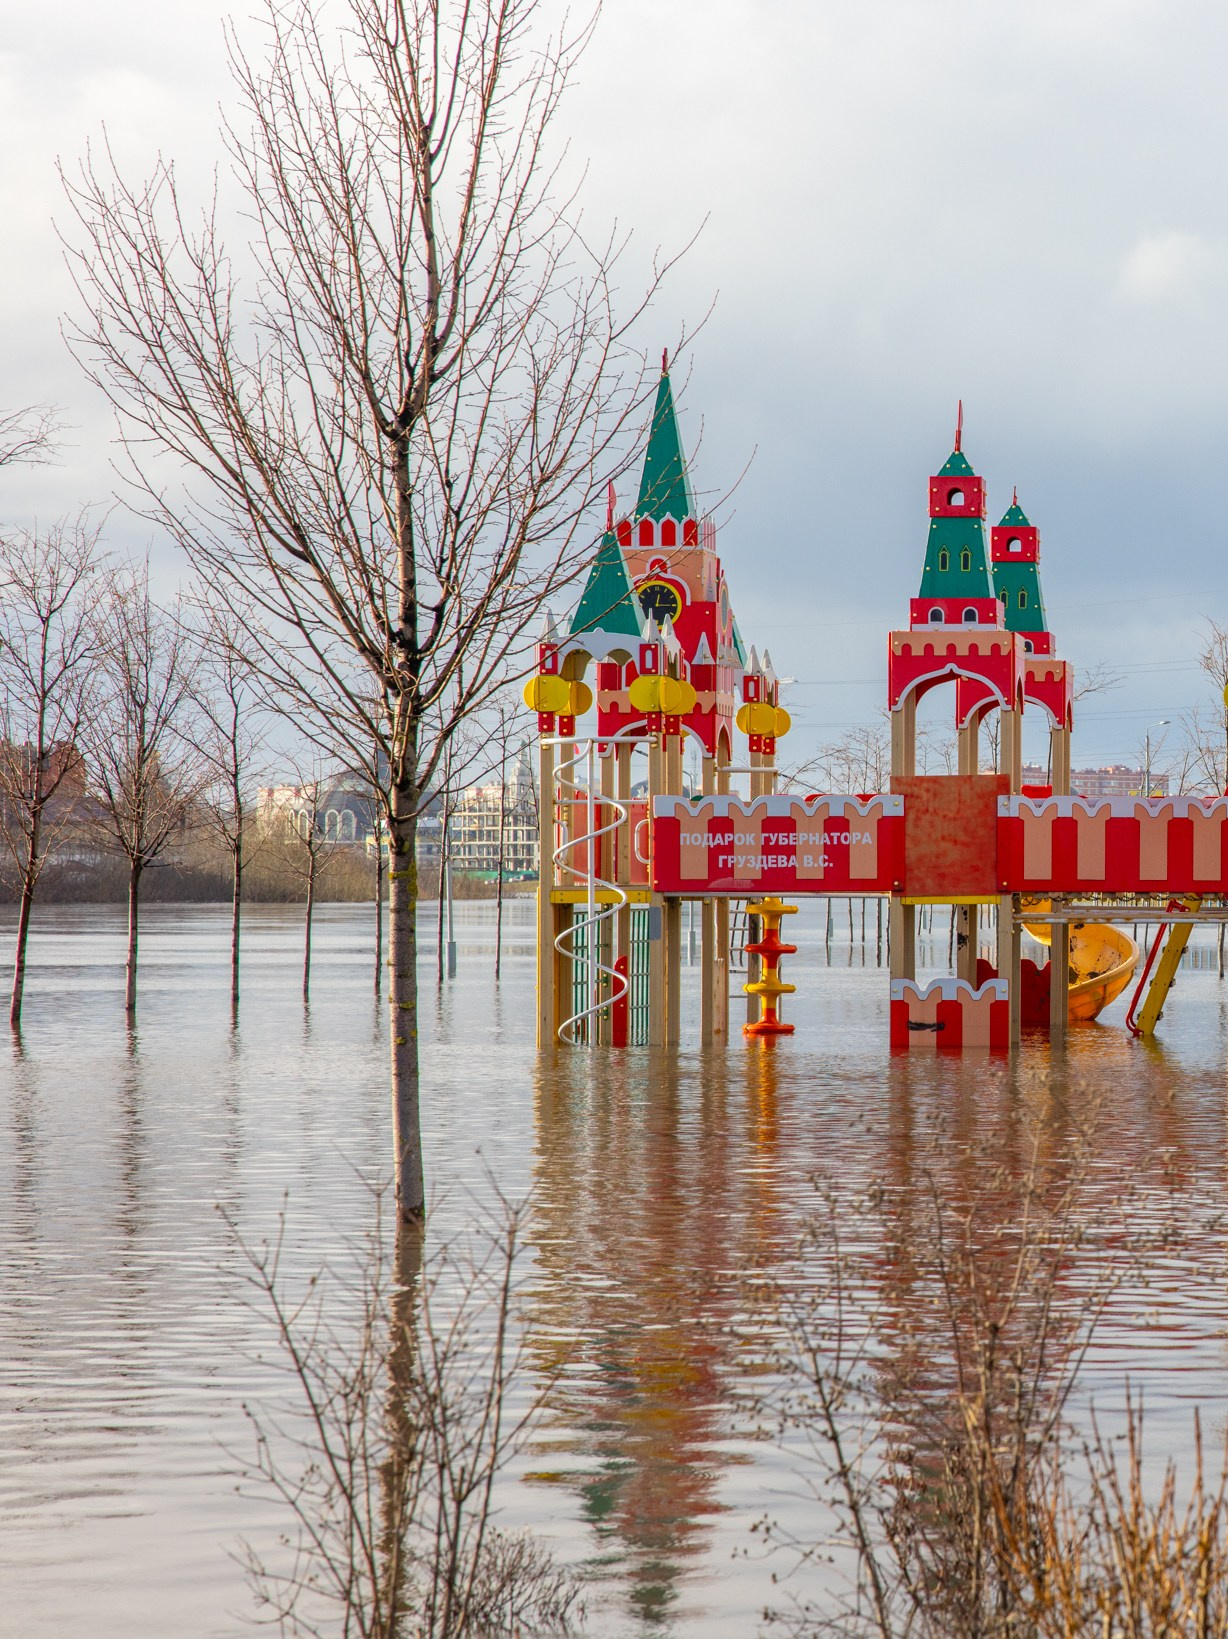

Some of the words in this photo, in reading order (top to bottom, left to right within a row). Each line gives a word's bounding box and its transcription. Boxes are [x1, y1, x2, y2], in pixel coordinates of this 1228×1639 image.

[680, 833, 755, 848] ПОДАРОК
[761, 832, 872, 846] ГУБЕРНАТОРА
[718, 855, 798, 870] ГРУЗДЕВА
[803, 855, 833, 867] В.С.
